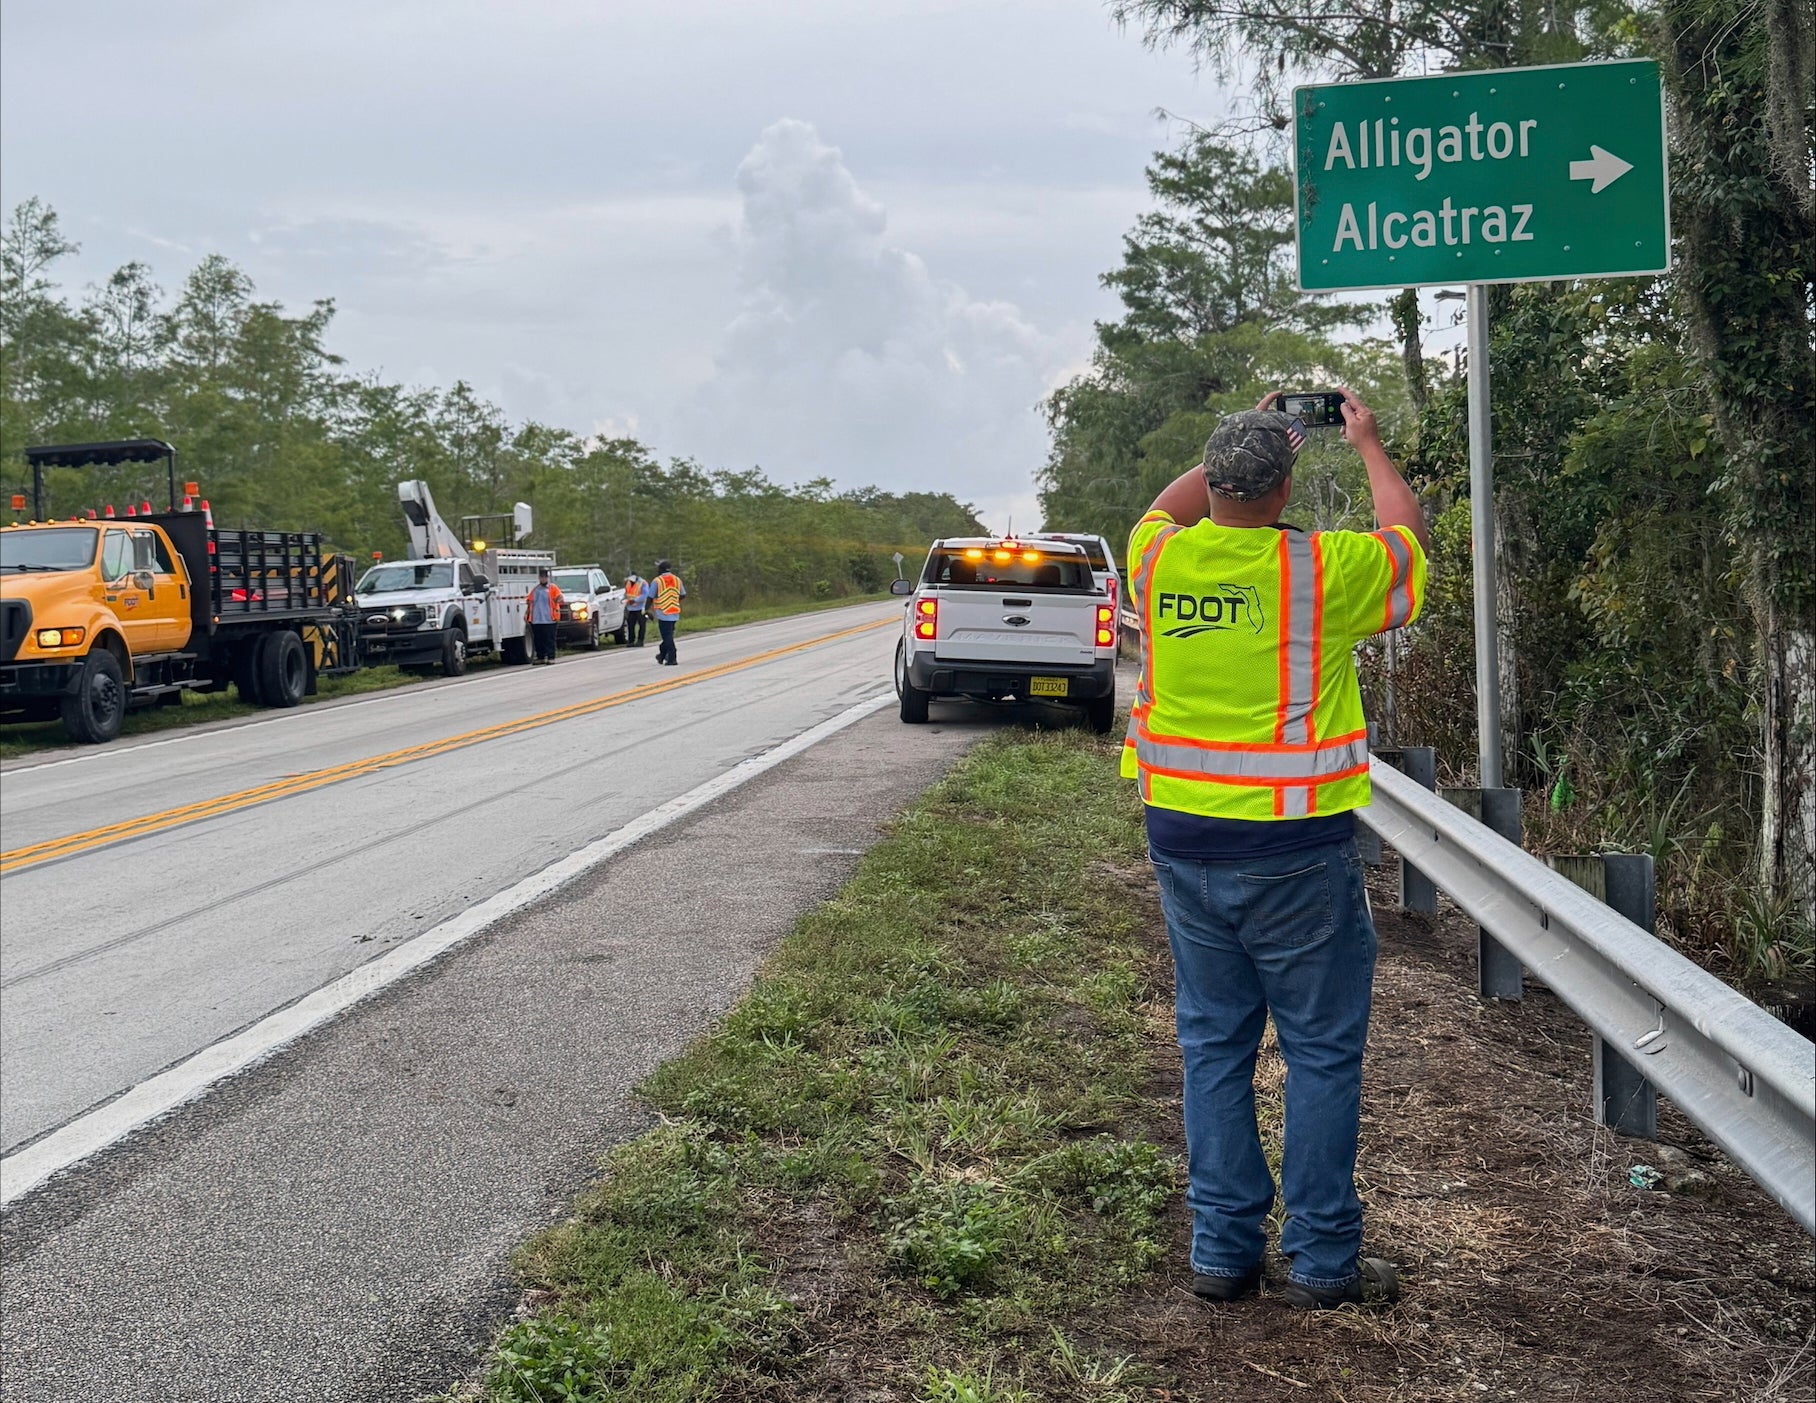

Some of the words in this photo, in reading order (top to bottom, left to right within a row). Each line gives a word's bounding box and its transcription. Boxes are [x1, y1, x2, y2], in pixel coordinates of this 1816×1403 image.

[1324, 111, 1537, 181] Alligator
[1333, 196, 1534, 253] Alcatraz
[1159, 592, 1246, 623] FDOT
